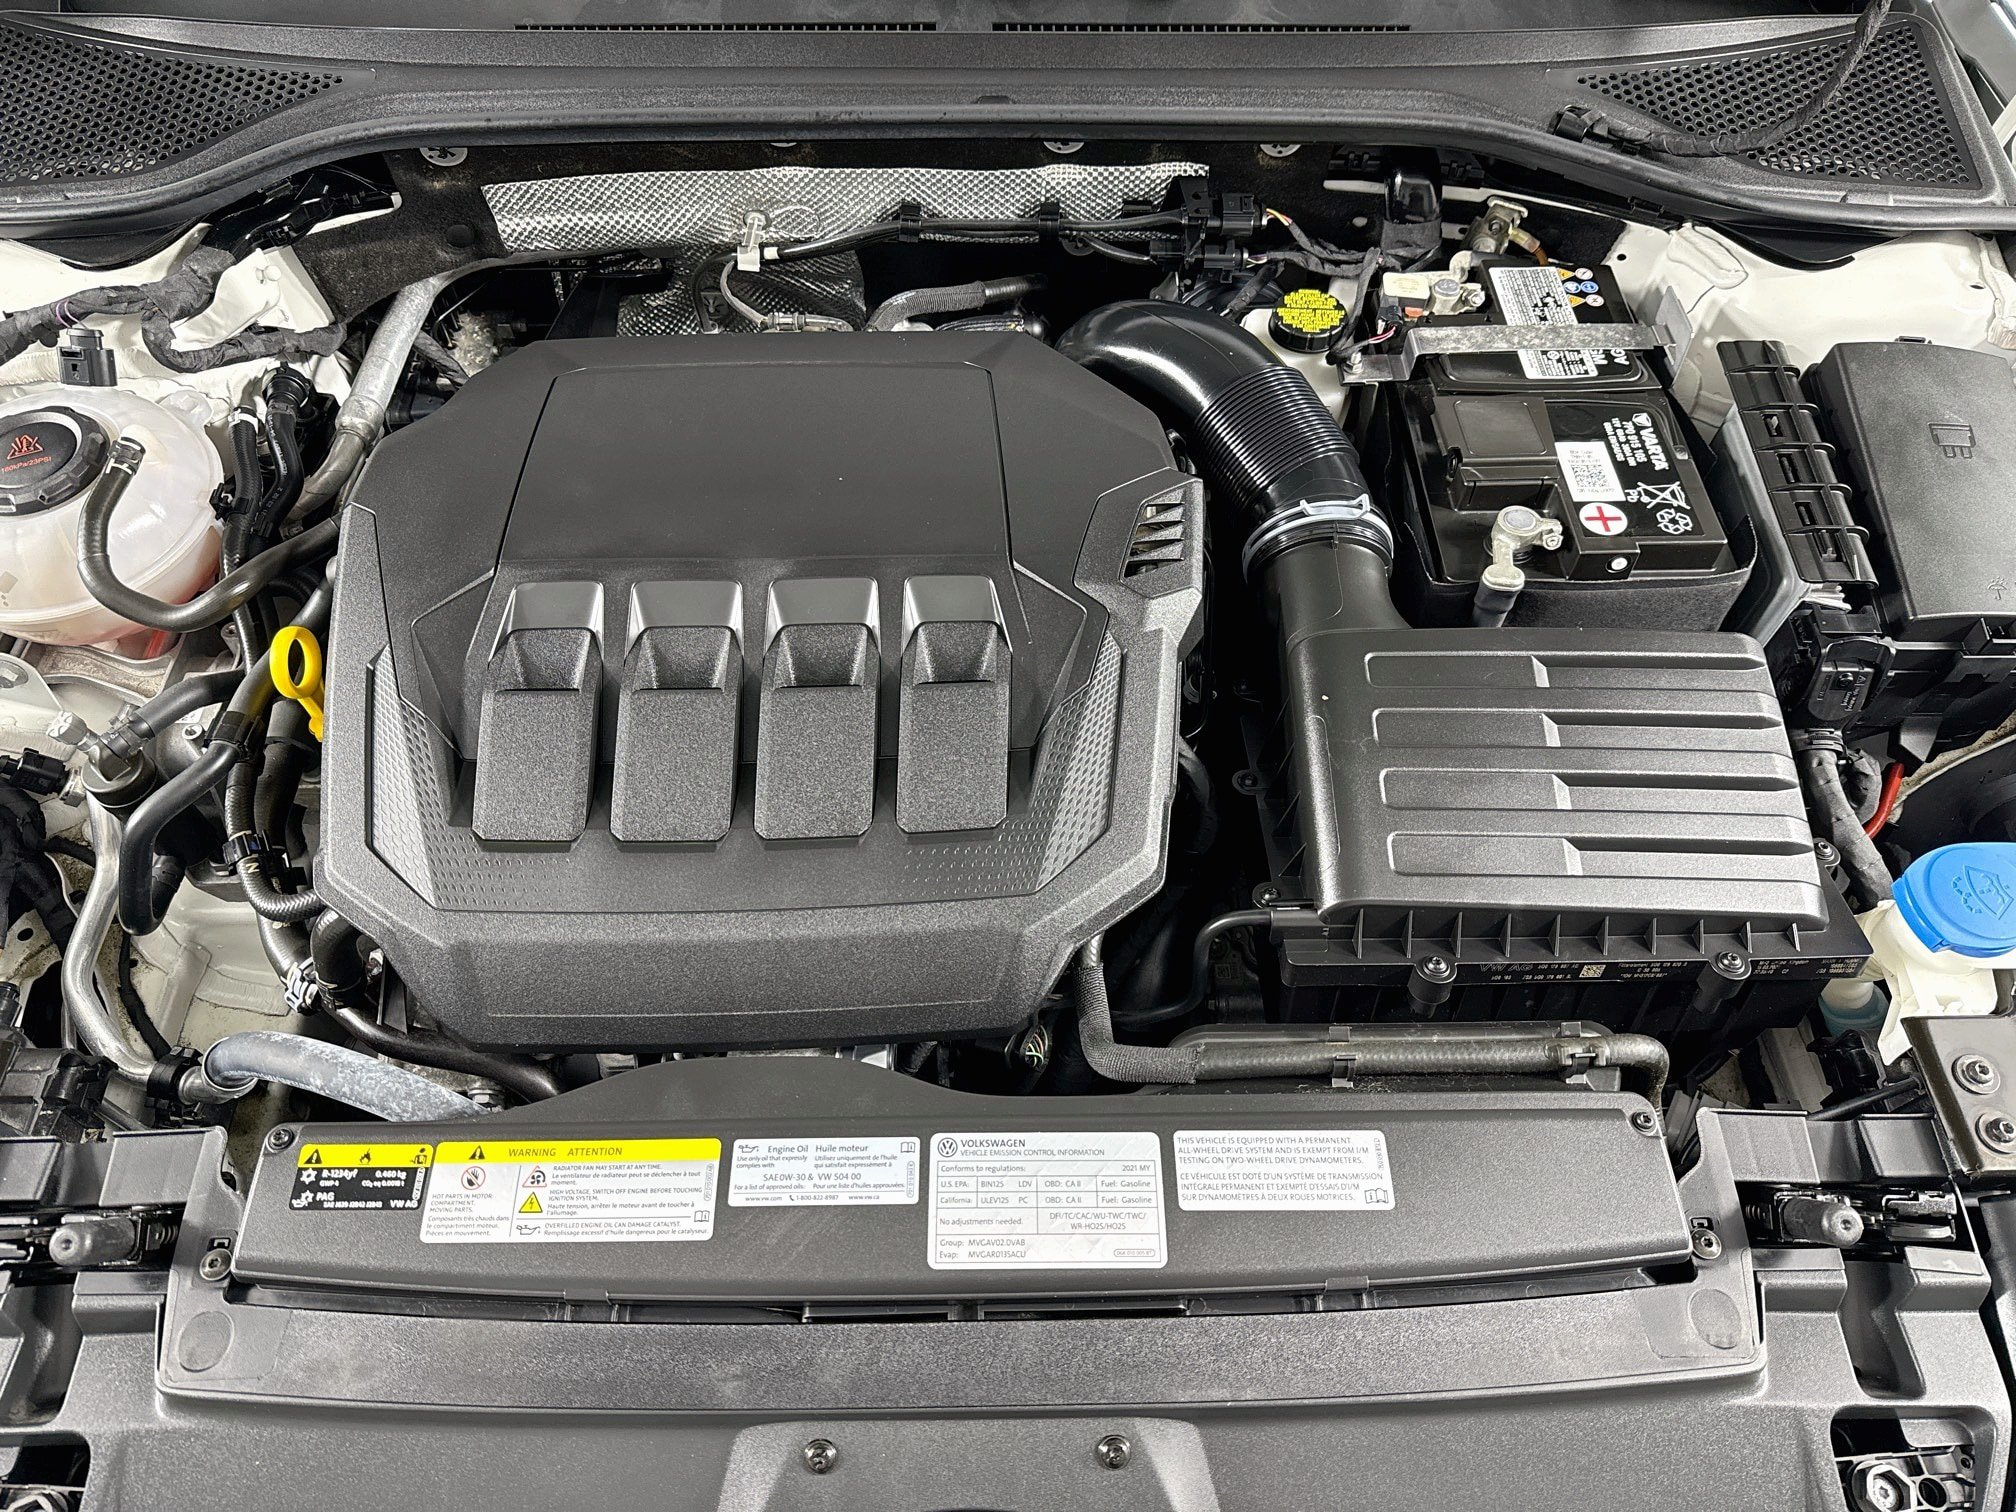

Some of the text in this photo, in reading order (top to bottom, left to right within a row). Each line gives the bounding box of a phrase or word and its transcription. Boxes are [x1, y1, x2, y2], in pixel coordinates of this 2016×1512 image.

[1627, 435, 1641, 448] 915
[1634, 449, 1647, 462] 105
[1640, 428, 1669, 470] VARTA
[961, 1139, 1026, 1147] VOLKSWAGEN
[1237, 1137, 1274, 1145] EQUIPPED
[509, 1148, 622, 1156] WARNING ATTENTION
[768, 1145, 795, 1154] Engine
[397, 1170, 406, 1179] kg
[1191, 1172, 1226, 1180] VÉHICULE
[1242, 1172, 1261, 1180] DOTÉ
[1285, 1172, 1315, 1180] SYSTÈME
[316, 1192, 335, 1200] PAG
[951, 1218, 993, 1226] adjustments
[940, 1239, 964, 1247] Group:
